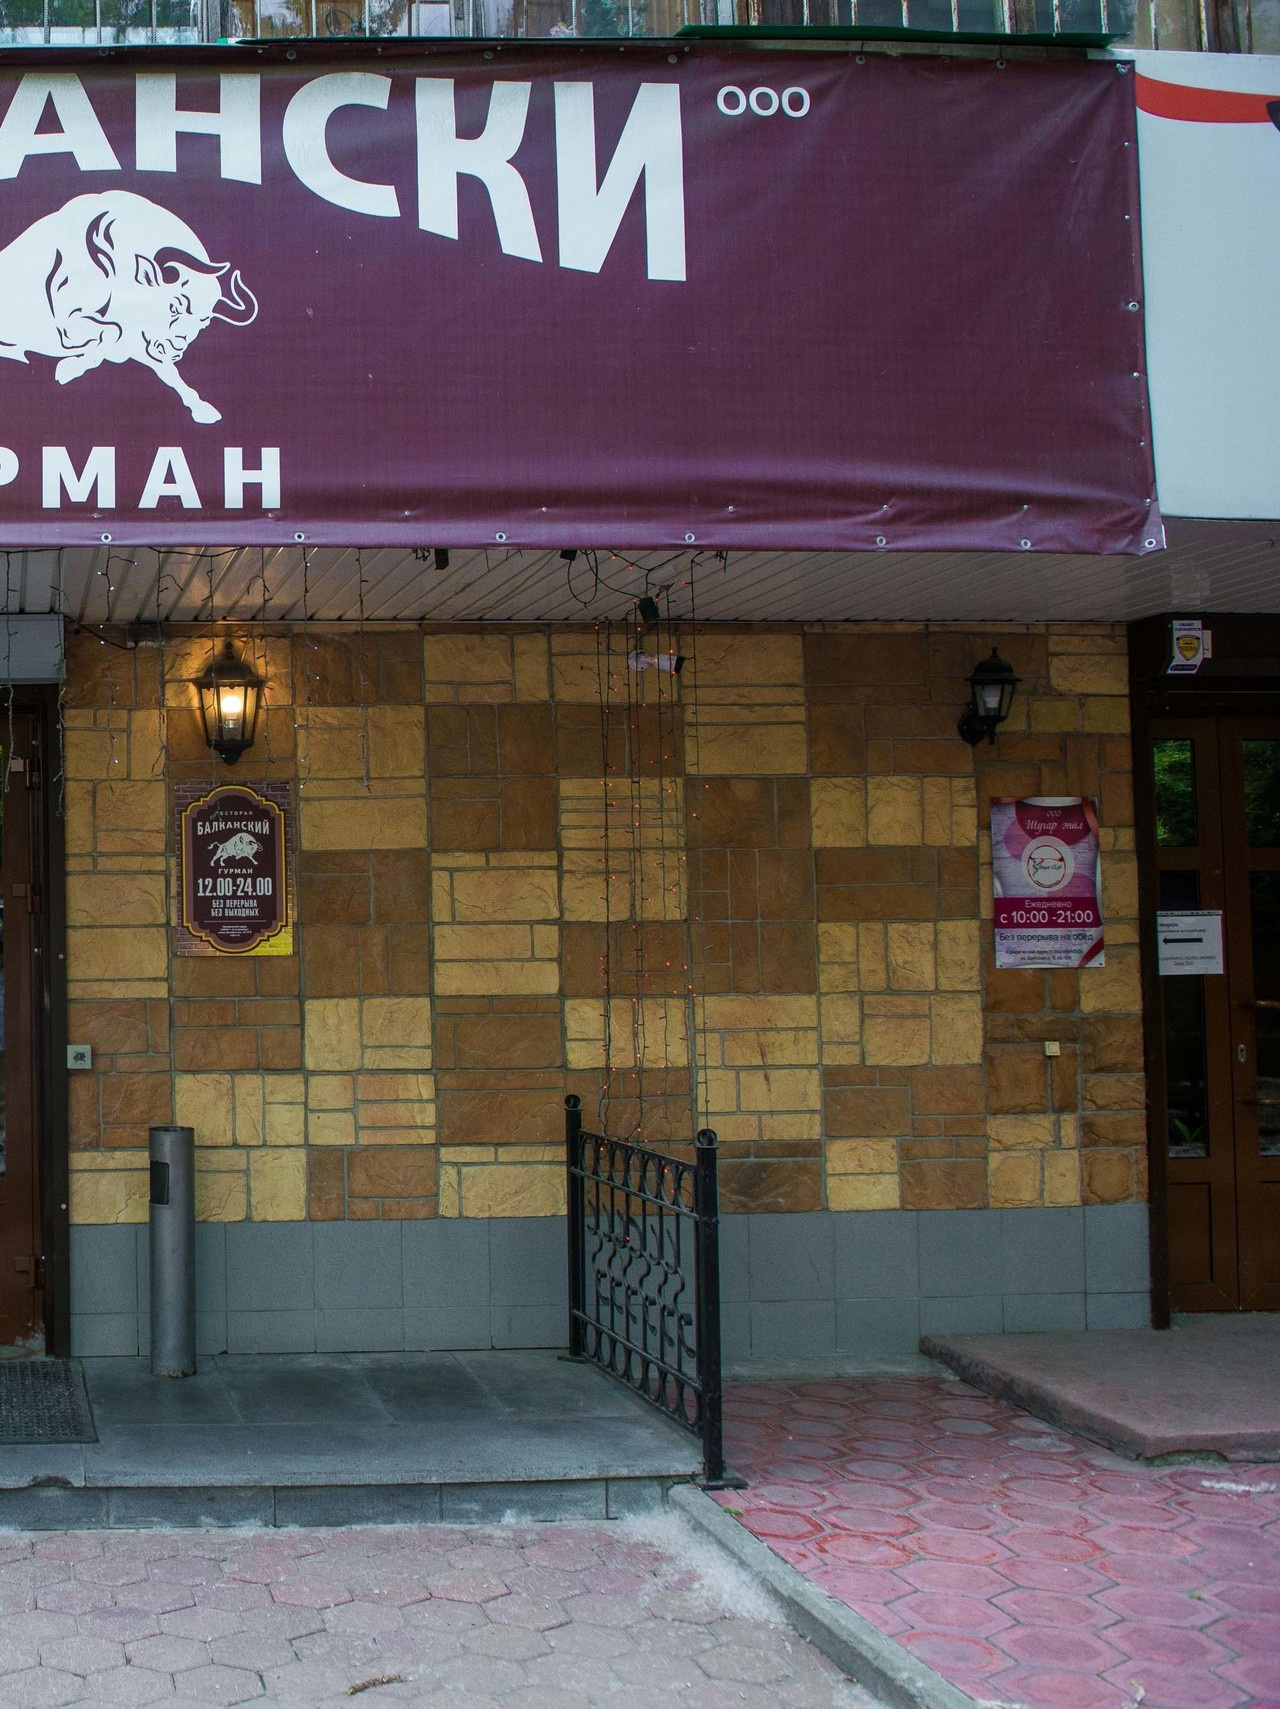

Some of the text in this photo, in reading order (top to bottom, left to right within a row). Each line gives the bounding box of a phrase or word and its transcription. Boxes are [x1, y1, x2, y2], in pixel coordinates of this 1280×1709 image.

[716, 86, 812, 118] ООО
[197, 818, 270, 836] БАЛКАНСКИЙ
[197, 877, 273, 897] 12.00-24.00
[212, 899, 258, 908] БЕЗ ПЕРЕРЫВА
[1024, 899, 1073, 909] Ежедневно
[210, 908, 259, 917] БЕЗ ВЫХОДНЫХ
[1000, 913, 1008, 923] с
[1011, 910, 1049, 923] 10:00
[999, 933, 1015, 941] Без
[1016, 934, 1059, 942] перерыва
[1072, 932, 1094, 942] обед
